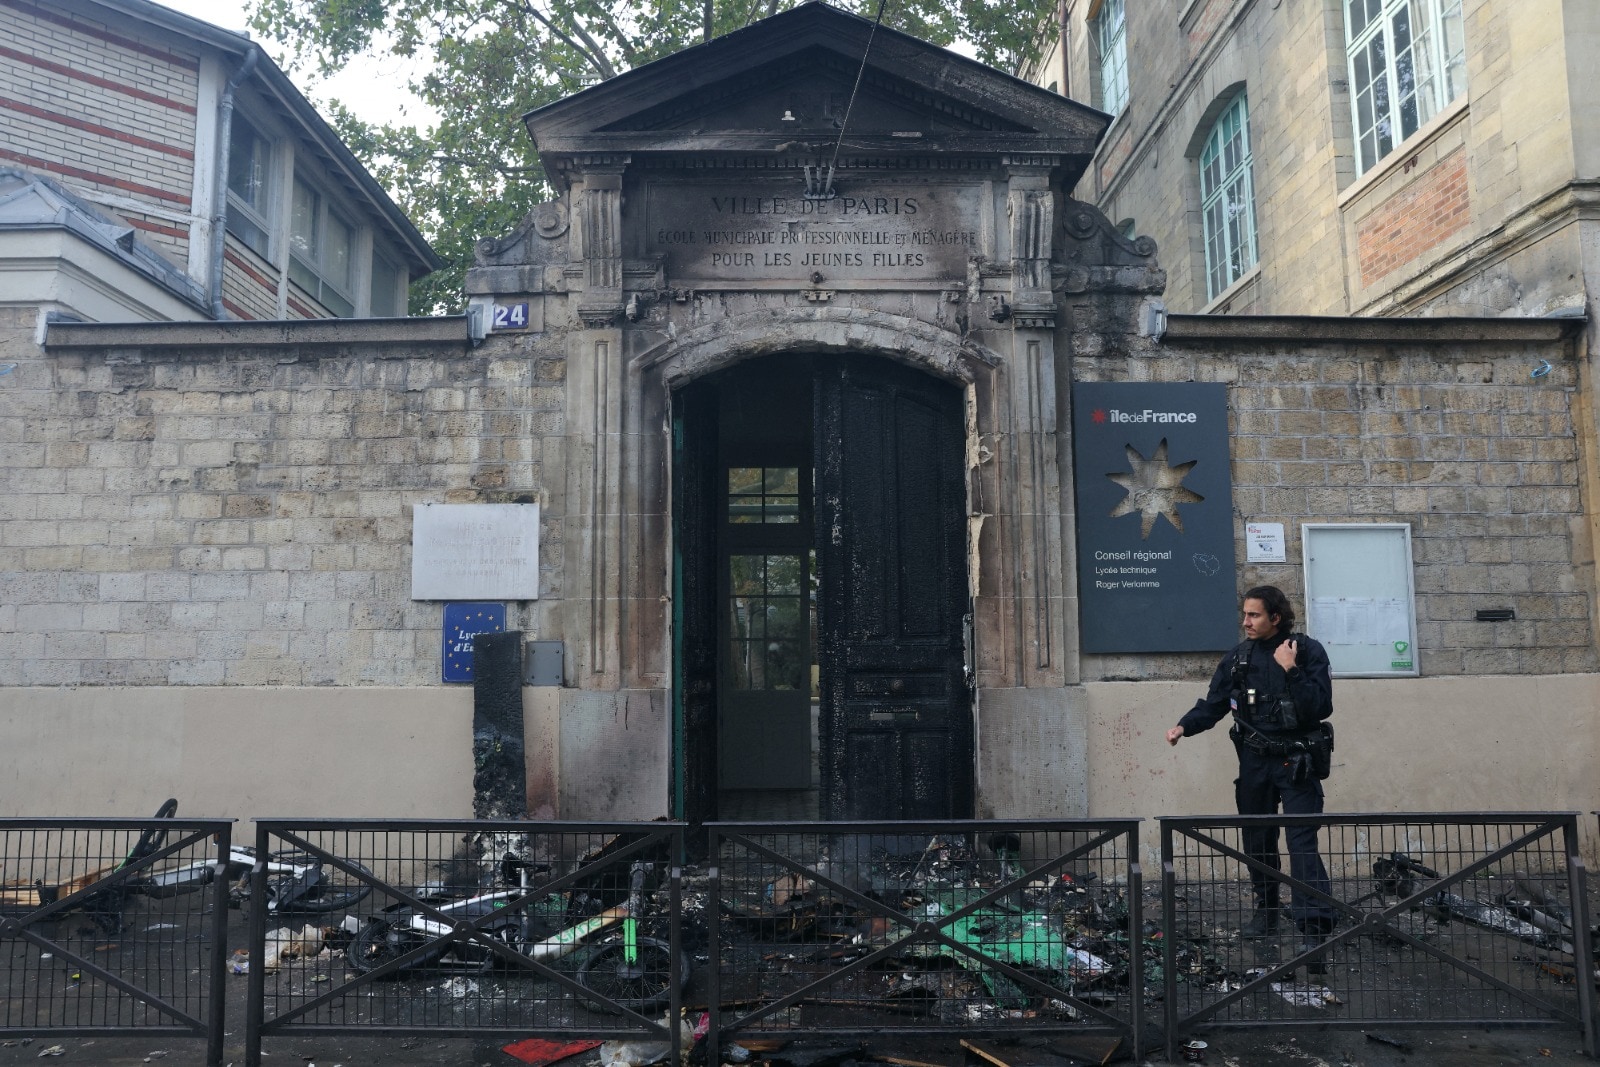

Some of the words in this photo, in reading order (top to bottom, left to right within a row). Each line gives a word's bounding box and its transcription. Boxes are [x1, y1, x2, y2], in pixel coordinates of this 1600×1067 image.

[711, 197, 787, 215] VILLE
[800, 198, 828, 215] DE
[842, 197, 917, 215] PARIS
[704, 231, 775, 245] MUNICIPALE
[781, 231, 890, 245] PROFESSIONNELLE
[712, 253, 755, 267] POUR
[764, 253, 792, 267] LES
[801, 253, 863, 267] JEUNES
[873, 253, 924, 267] FILLES
[495, 304, 525, 326] 24
[1094, 550, 1131, 560] Conseil
[1133, 550, 1172, 562] régional
[1095, 566, 1118, 576] Lycée
[1119, 566, 1157, 576] technique
[1095, 580, 1119, 590] Roger
[1121, 580, 1160, 589] Verlomme
